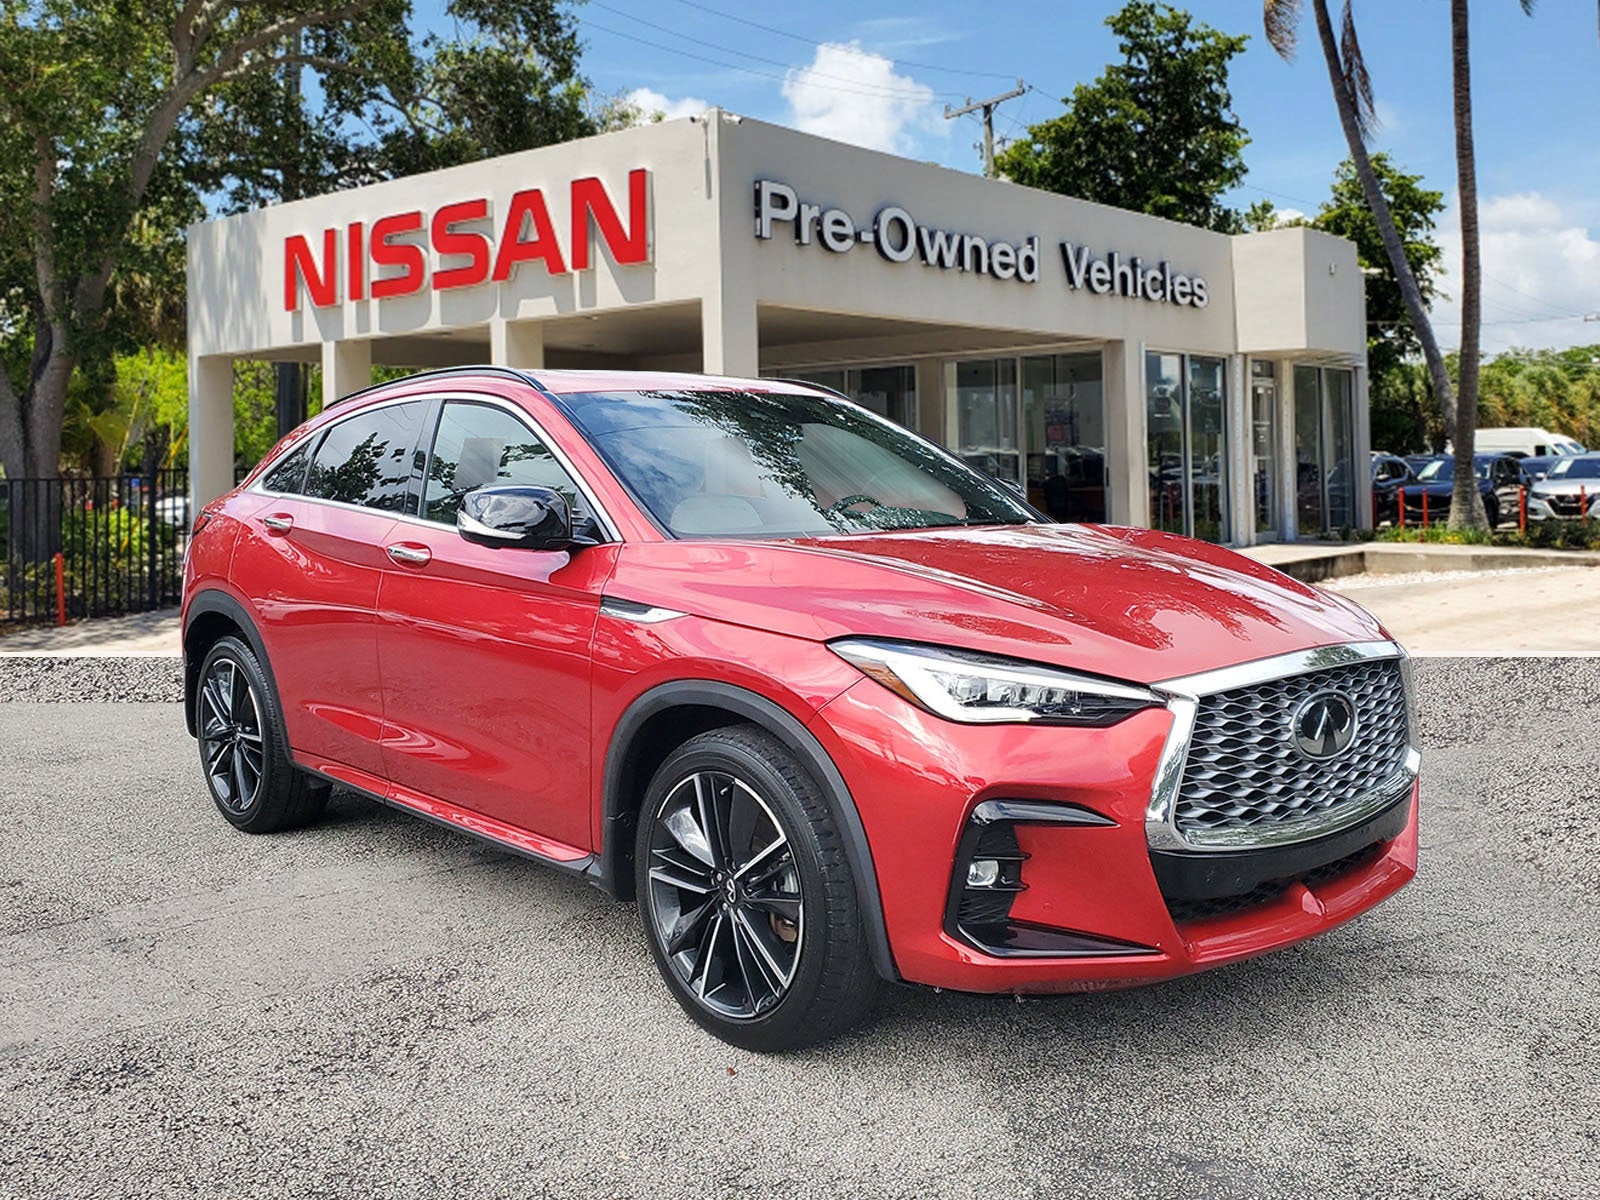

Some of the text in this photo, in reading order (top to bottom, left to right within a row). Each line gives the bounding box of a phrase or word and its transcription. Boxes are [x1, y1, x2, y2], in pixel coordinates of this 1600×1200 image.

[285, 168, 648, 312] NISSAN
[755, 180, 1209, 309] Pre-Owned Vehicles
